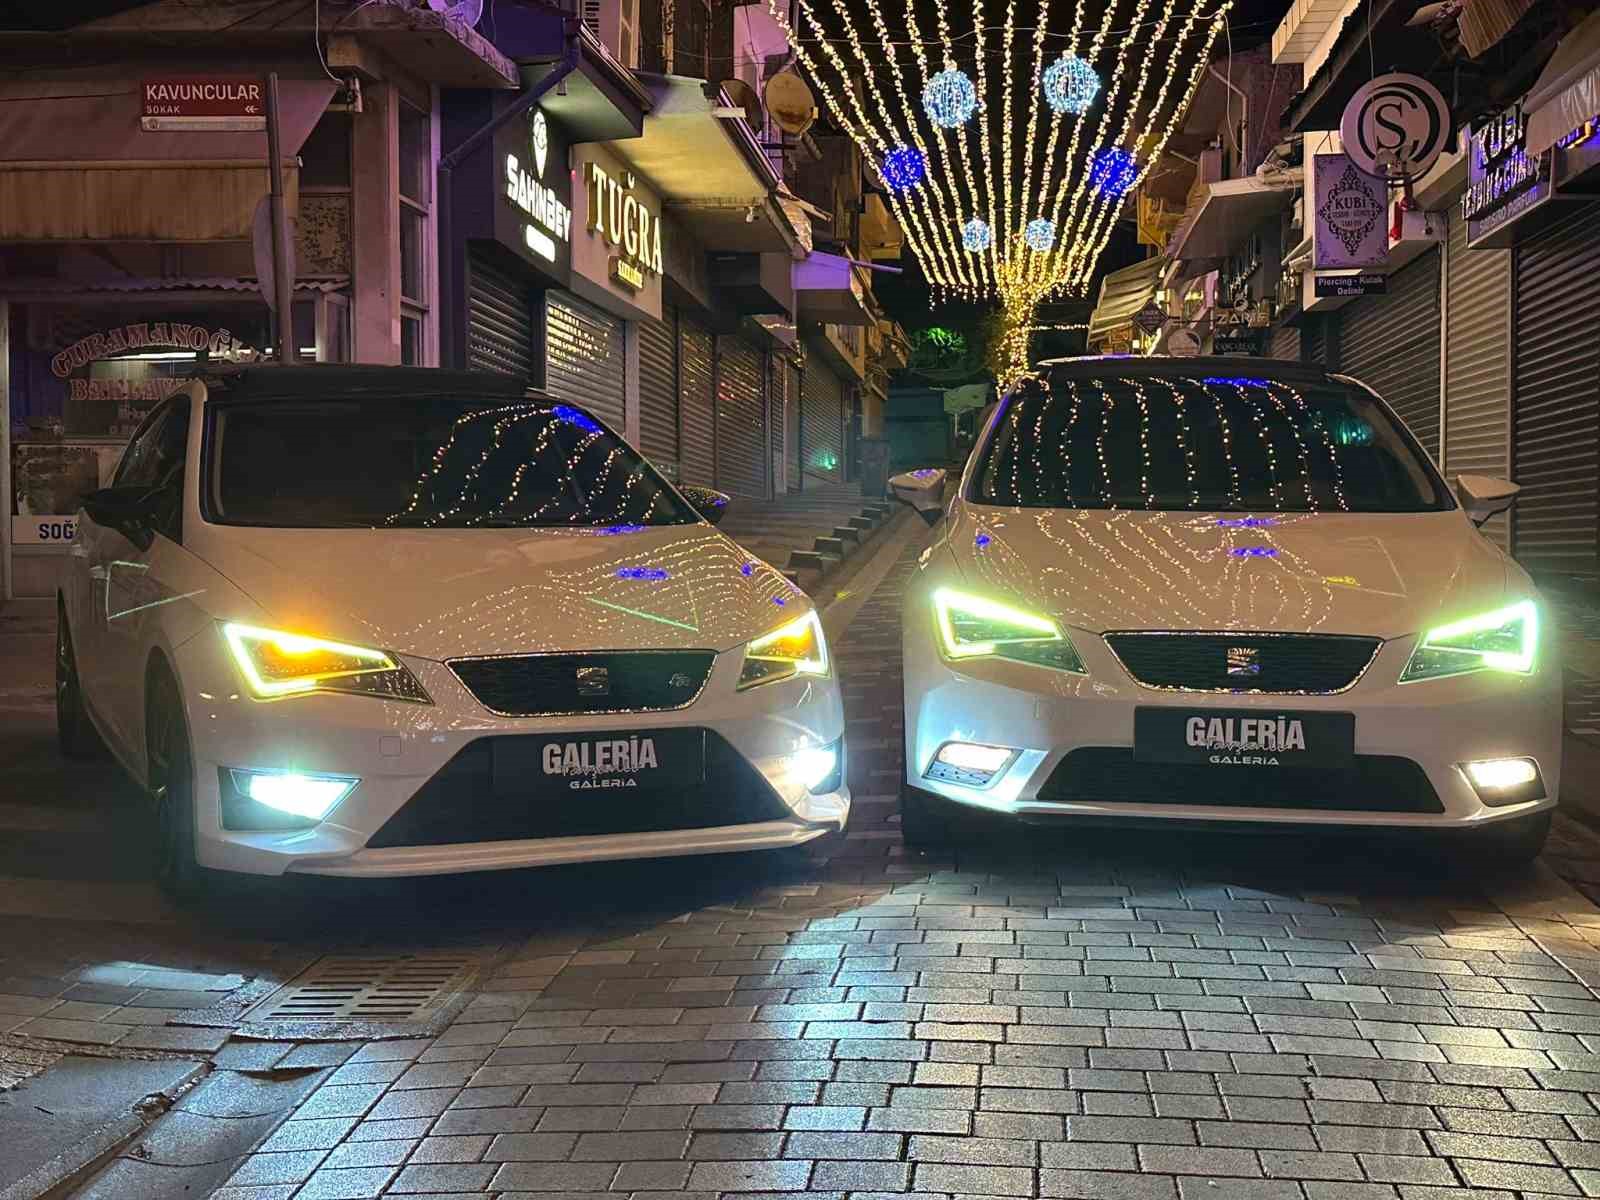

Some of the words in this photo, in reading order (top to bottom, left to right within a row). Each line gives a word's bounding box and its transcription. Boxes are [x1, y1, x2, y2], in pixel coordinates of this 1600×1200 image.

[146, 84, 260, 100] KAVUNCULAR
[146, 105, 180, 114] SOKAK
[592, 163, 664, 275] TUĞRA
[39, 520, 78, 540] SOĞ
[1185, 715, 1306, 750] GALERİA
[542, 735, 658, 775] GALERİA
